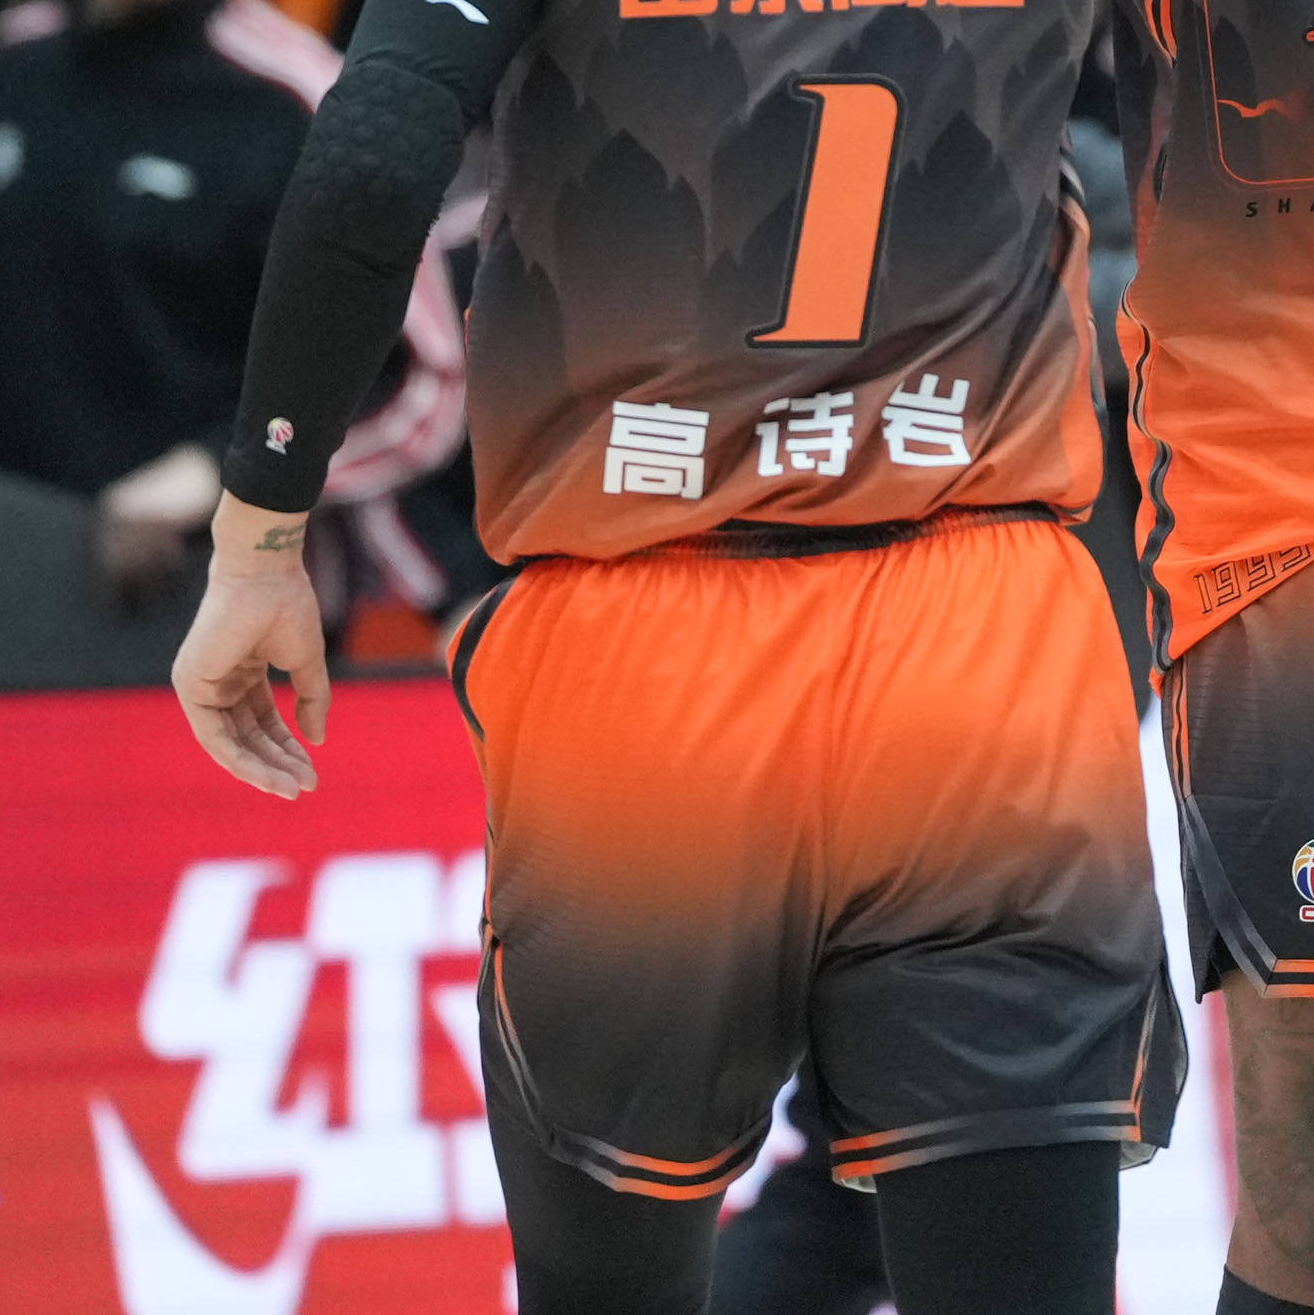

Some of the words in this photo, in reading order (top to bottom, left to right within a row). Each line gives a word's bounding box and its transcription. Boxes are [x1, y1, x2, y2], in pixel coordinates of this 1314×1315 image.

[747, 76, 903, 347] 1
[602, 372, 974, 501] 高诗岩
[138, 850, 507, 1233] 红
